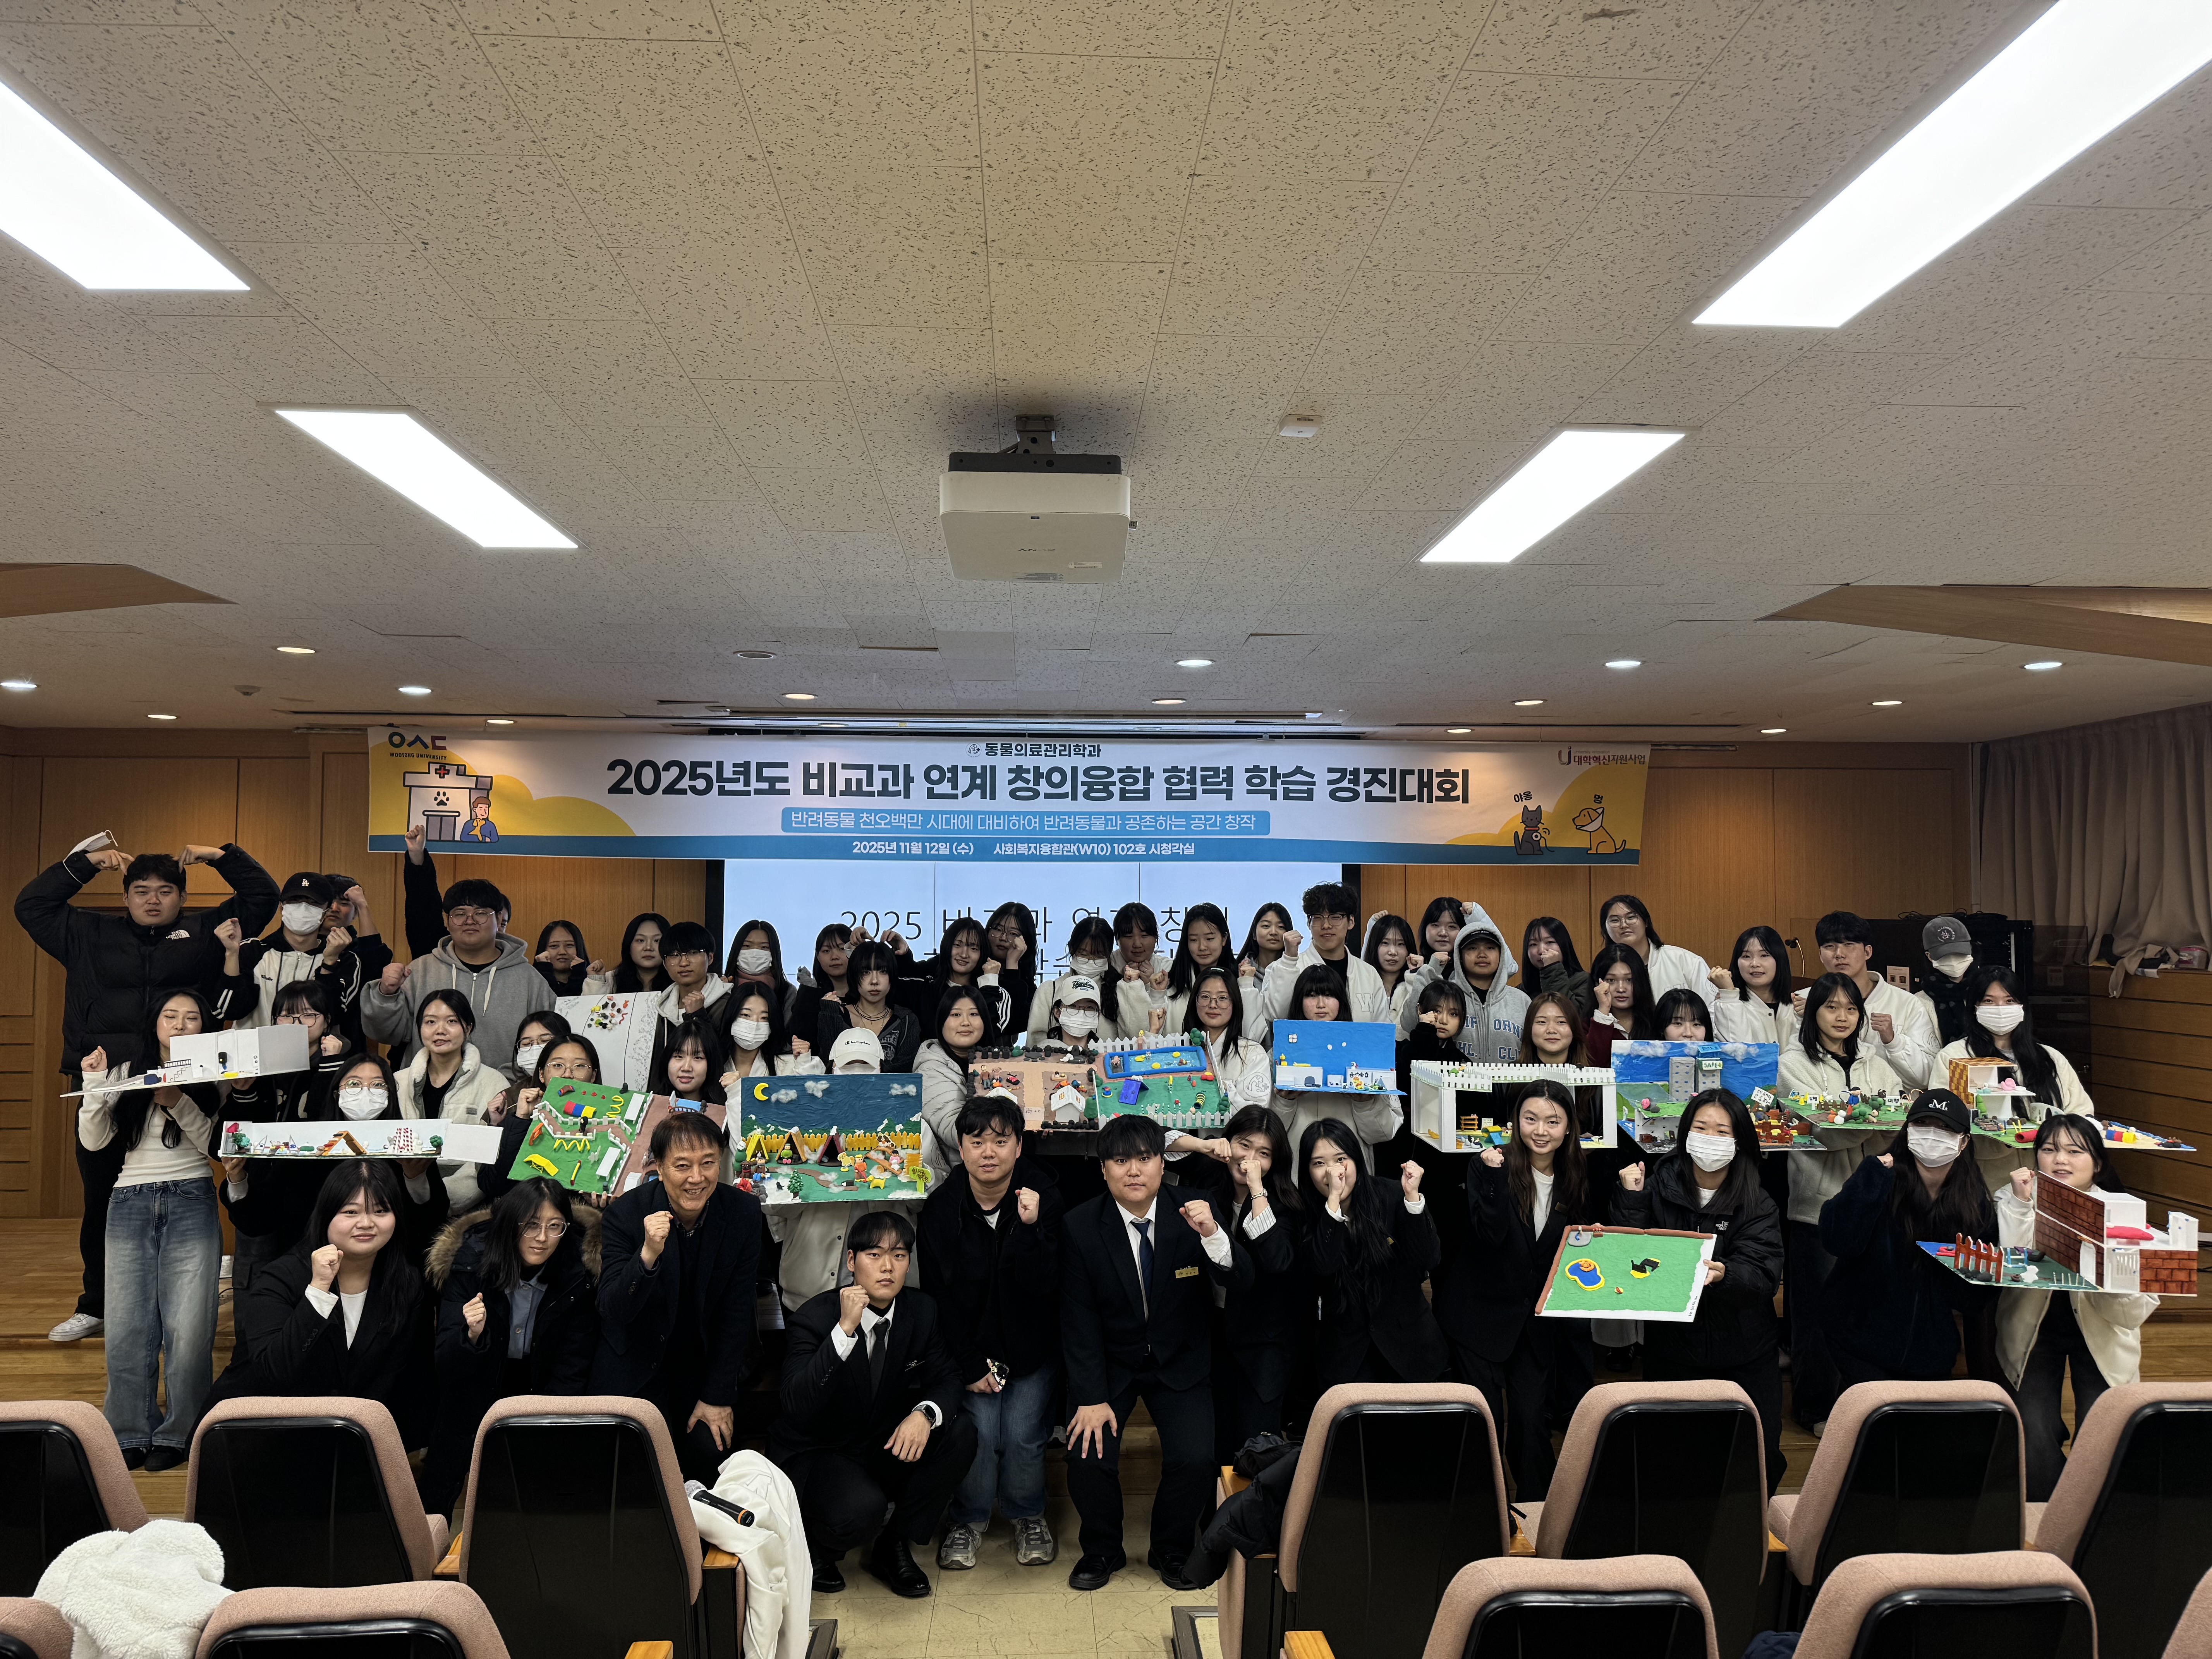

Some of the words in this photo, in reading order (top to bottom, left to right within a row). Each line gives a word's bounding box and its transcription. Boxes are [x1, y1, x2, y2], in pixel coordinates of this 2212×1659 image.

[985, 743, 1101, 758] 동물의료관리학과
[1573, 754, 1645, 766] 대학혁신지원사업
[607, 759, 790, 796] 2025년도
[803, 762, 915, 799] 비교과
[923, 764, 996, 800] 연계
[1007, 765, 1154, 802] 창의융합
[1163, 765, 1233, 801] 협력
[1244, 765, 1316, 801] 학습
[1327, 767, 1469, 804] 경진대회
[1513, 791, 1532, 803] 야옹
[1593, 794, 1604, 804] 멍
[792, 811, 855, 828] 반려동물
[859, 812, 923, 829] 천오백만
[927, 814, 973, 830] 시대에
[978, 814, 1039, 830] 대비하여
[1044, 815, 1122, 831] 반려동물과
[1125, 815, 1186, 830] 공존하는
[1190, 814, 1221, 830] 공간
[1225, 814, 1256, 830] 창작
[852, 841, 897, 854] 2025년
[899, 842, 922, 854] 11월
[925, 842, 950, 854] 12일
[953, 842, 974, 855] (수)
[993, 843, 1111, 856] 사회복지융합관(W10)
[1113, 843, 1146, 855] 102호
[1149, 843, 1195, 855] 시청각실
[302, 878, 309, 886] LA
[841, 911, 921, 940] 2025
